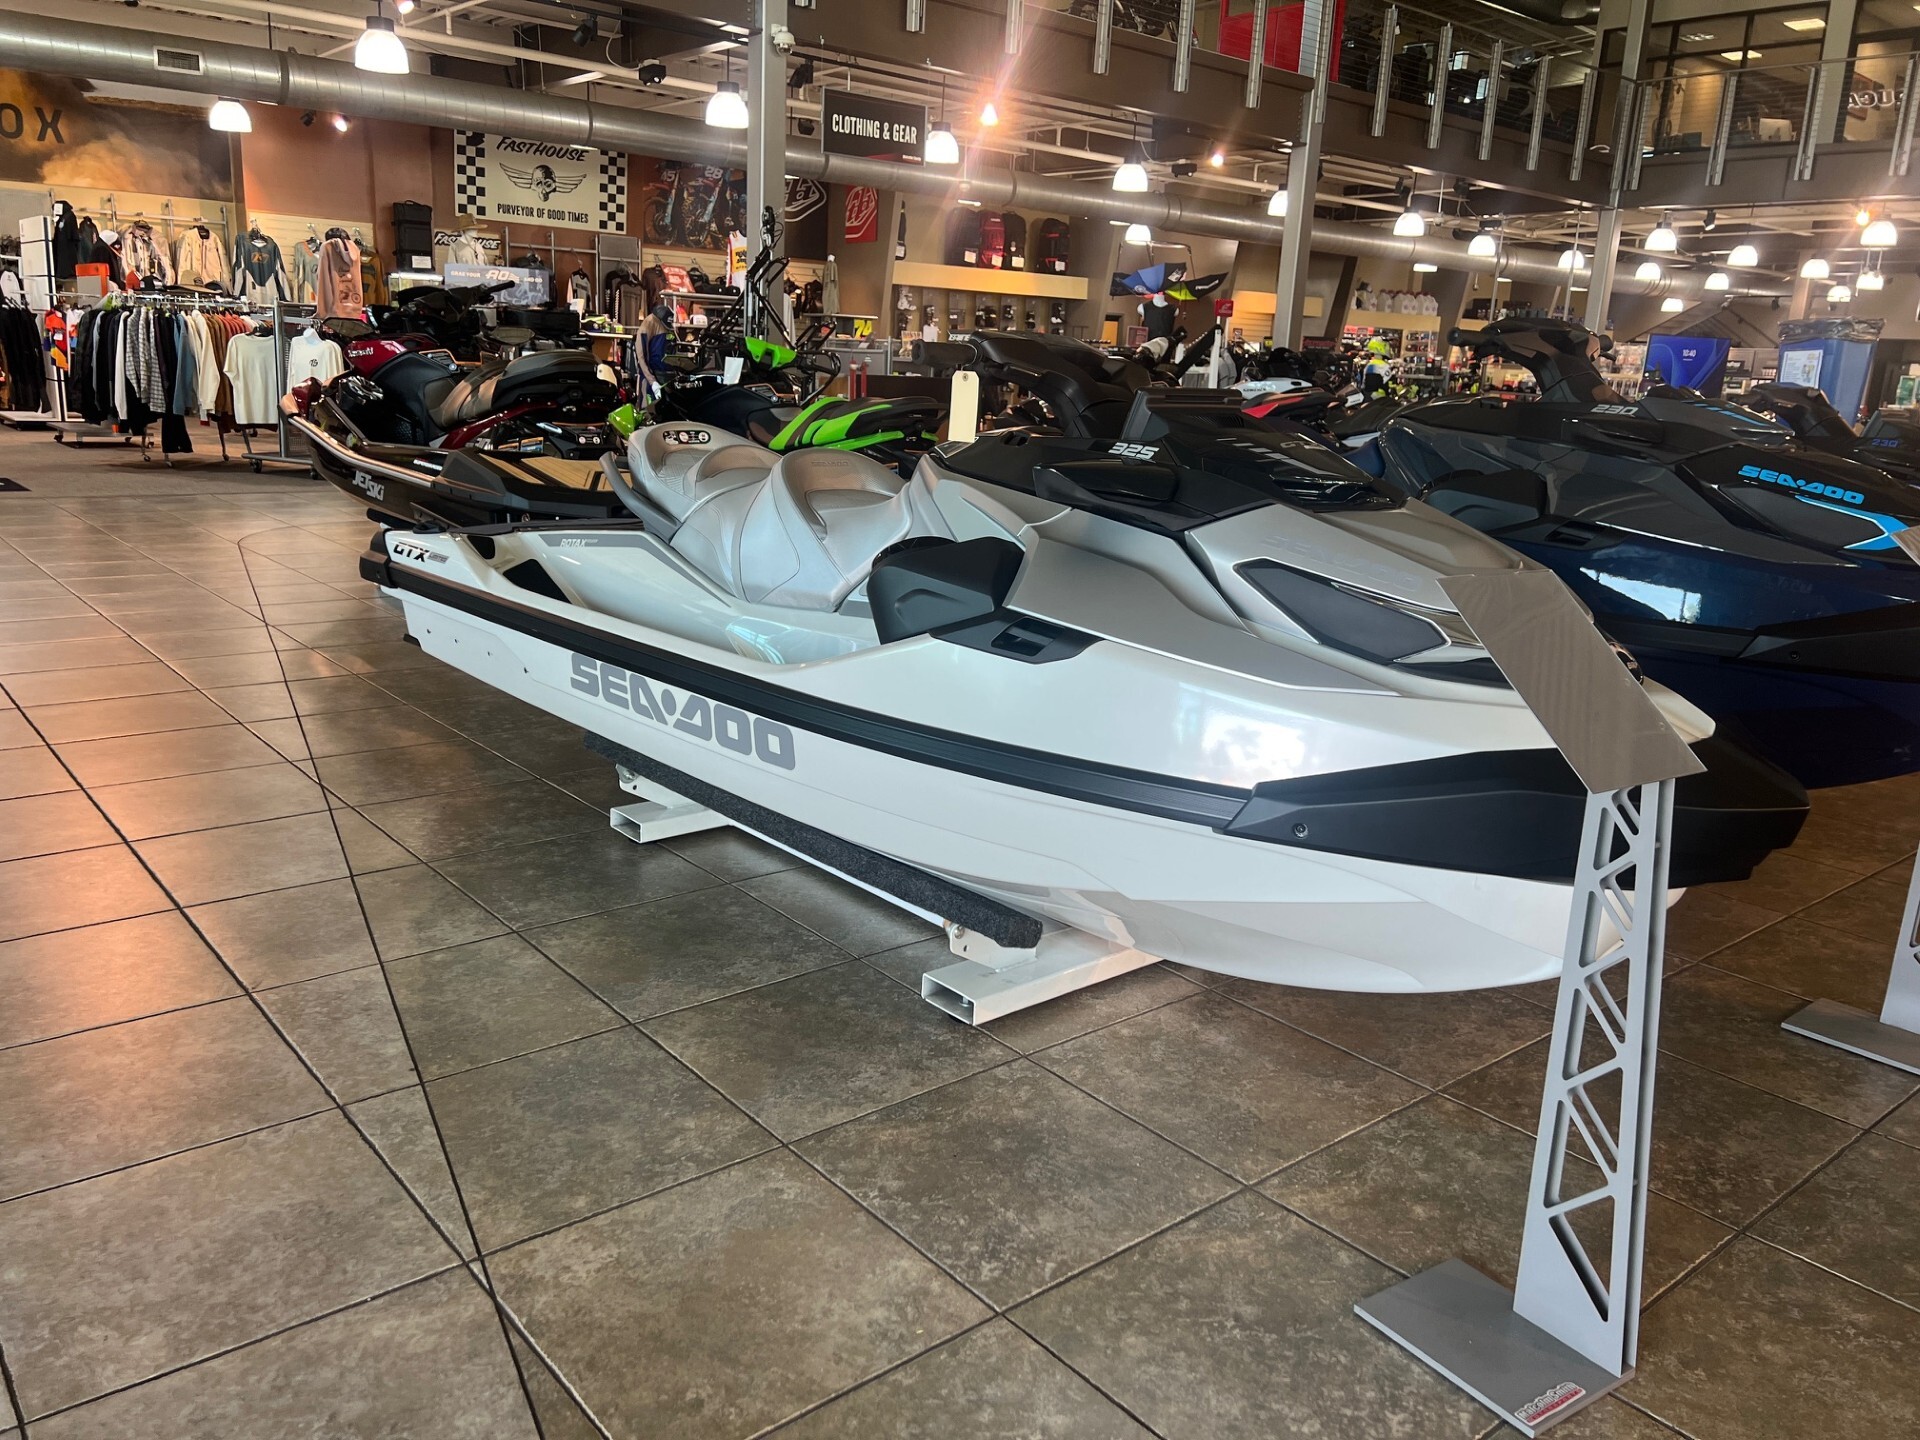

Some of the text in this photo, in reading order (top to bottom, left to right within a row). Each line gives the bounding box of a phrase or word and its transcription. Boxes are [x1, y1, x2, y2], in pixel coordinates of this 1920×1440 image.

[832, 113, 917, 145] CLOTHING & GEAR
[496, 136, 590, 162] FASTHOUSE
[497, 203, 589, 223] PURVEYOR OF GOOD TIMES
[1590, 404, 1639, 415] 230
[1108, 442, 1160, 460] 325
[1871, 438, 1899, 448] 230
[560, 538, 587, 549] ROTAX
